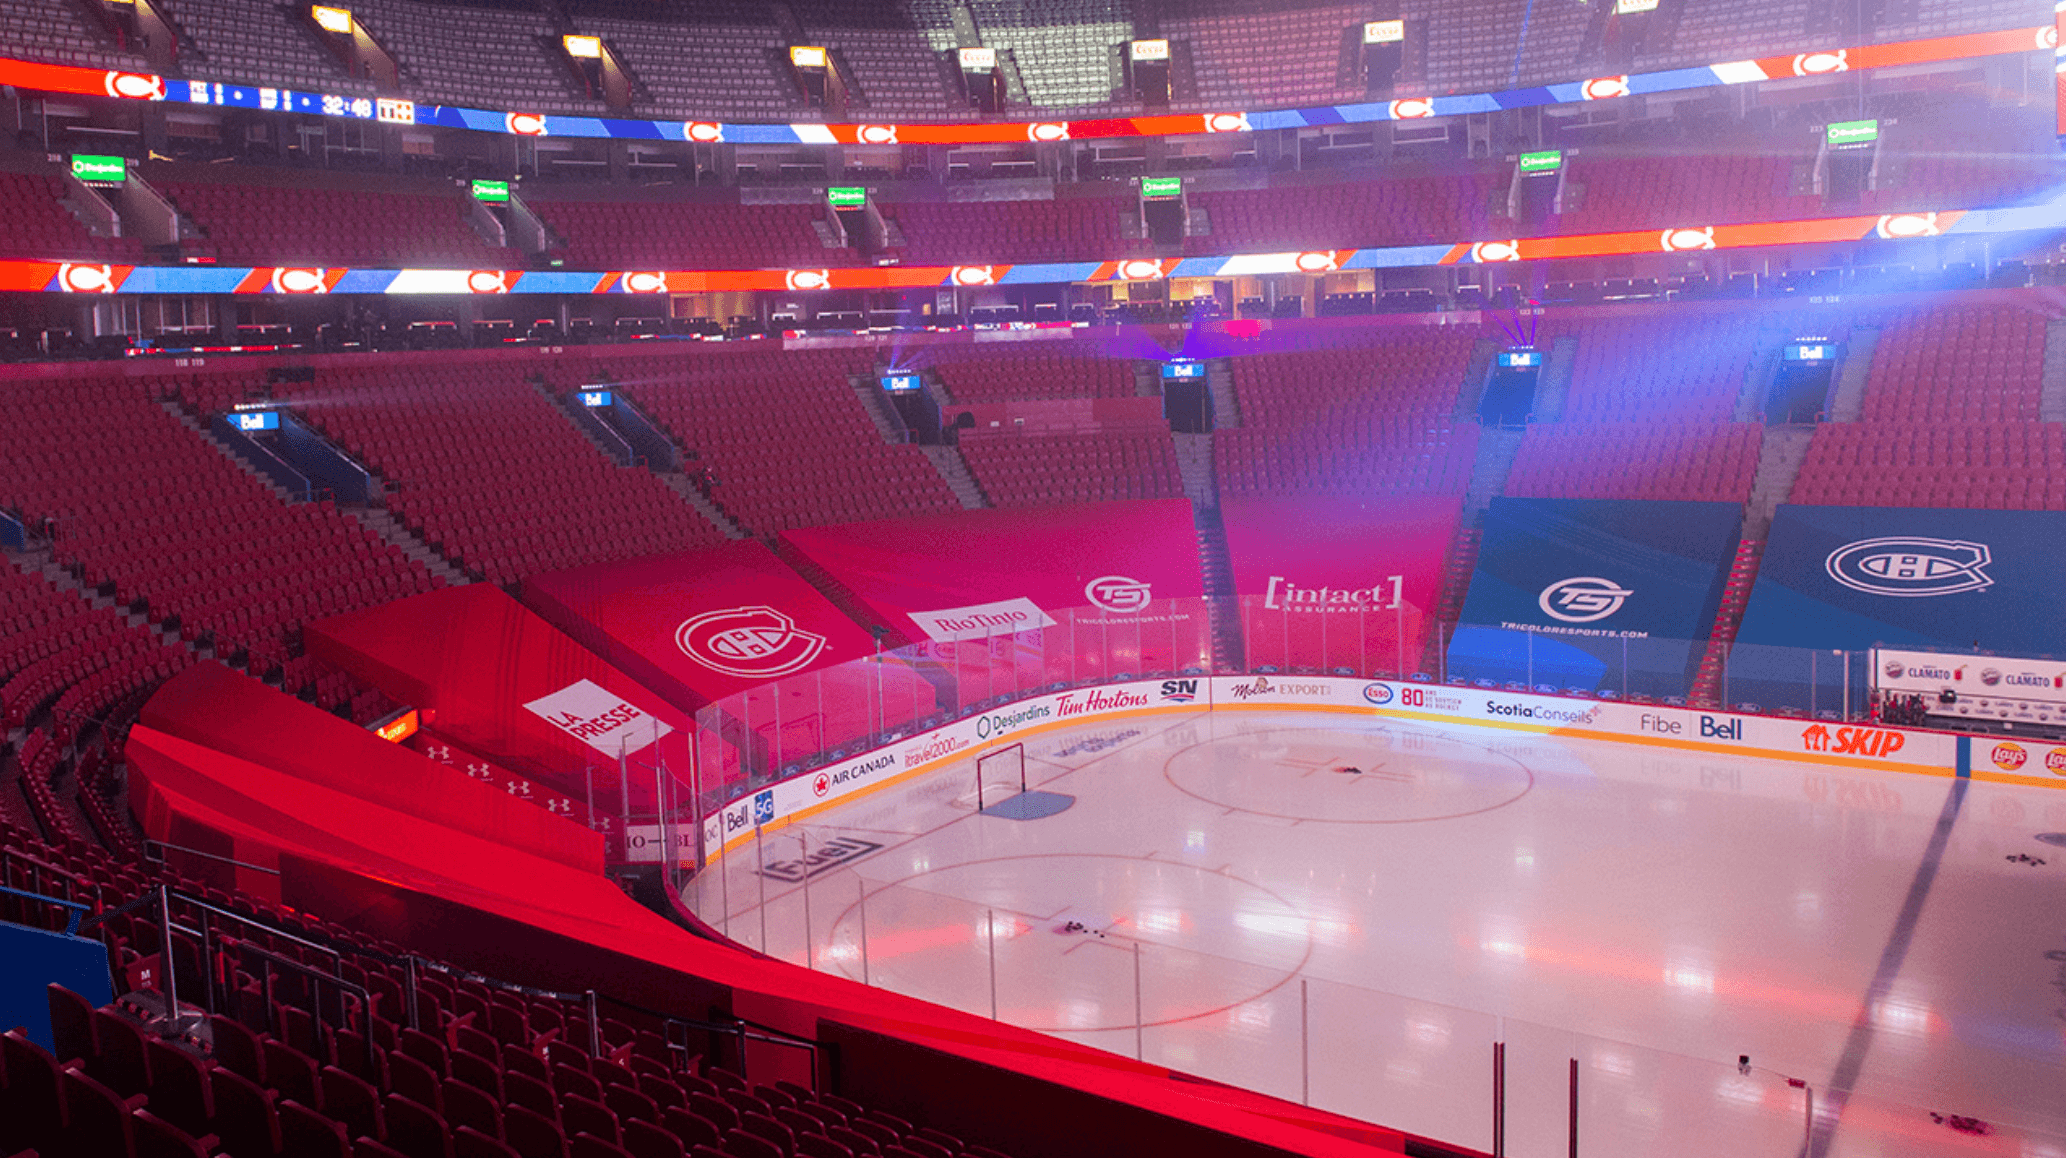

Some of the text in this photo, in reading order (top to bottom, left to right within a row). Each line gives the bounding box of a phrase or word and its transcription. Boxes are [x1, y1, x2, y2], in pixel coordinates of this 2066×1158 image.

[322, 95, 371, 118] 32:48
[1510, 353, 1530, 366] Bell
[1800, 346, 1823, 359] Bell
[1174, 364, 1193, 377] Bell
[240, 413, 265, 430] Bell
[1283, 604, 1381, 614] ASSURANCE
[1501, 621, 1649, 639] TRICOLORESPORTS.COM
[1908, 667, 1950, 680] CLAMATO
[2006, 674, 2050, 687] CLAMATO
[1161, 680, 1198, 696] SN
[1279, 683, 1326, 696] EXPORT
[1401, 687, 1424, 708] 80
[1056, 689, 1148, 717] Tim Hortons
[547, 709, 584, 731] LA
[569, 702, 643, 742] PRESSE
[993, 705, 1051, 731] Desjardins
[1641, 713, 1742, 740] Fibe Bell
[1831, 727, 1905, 758] SKIP
[832, 754, 896, 787] AIR CANADA
[727, 804, 748, 832] Bell
